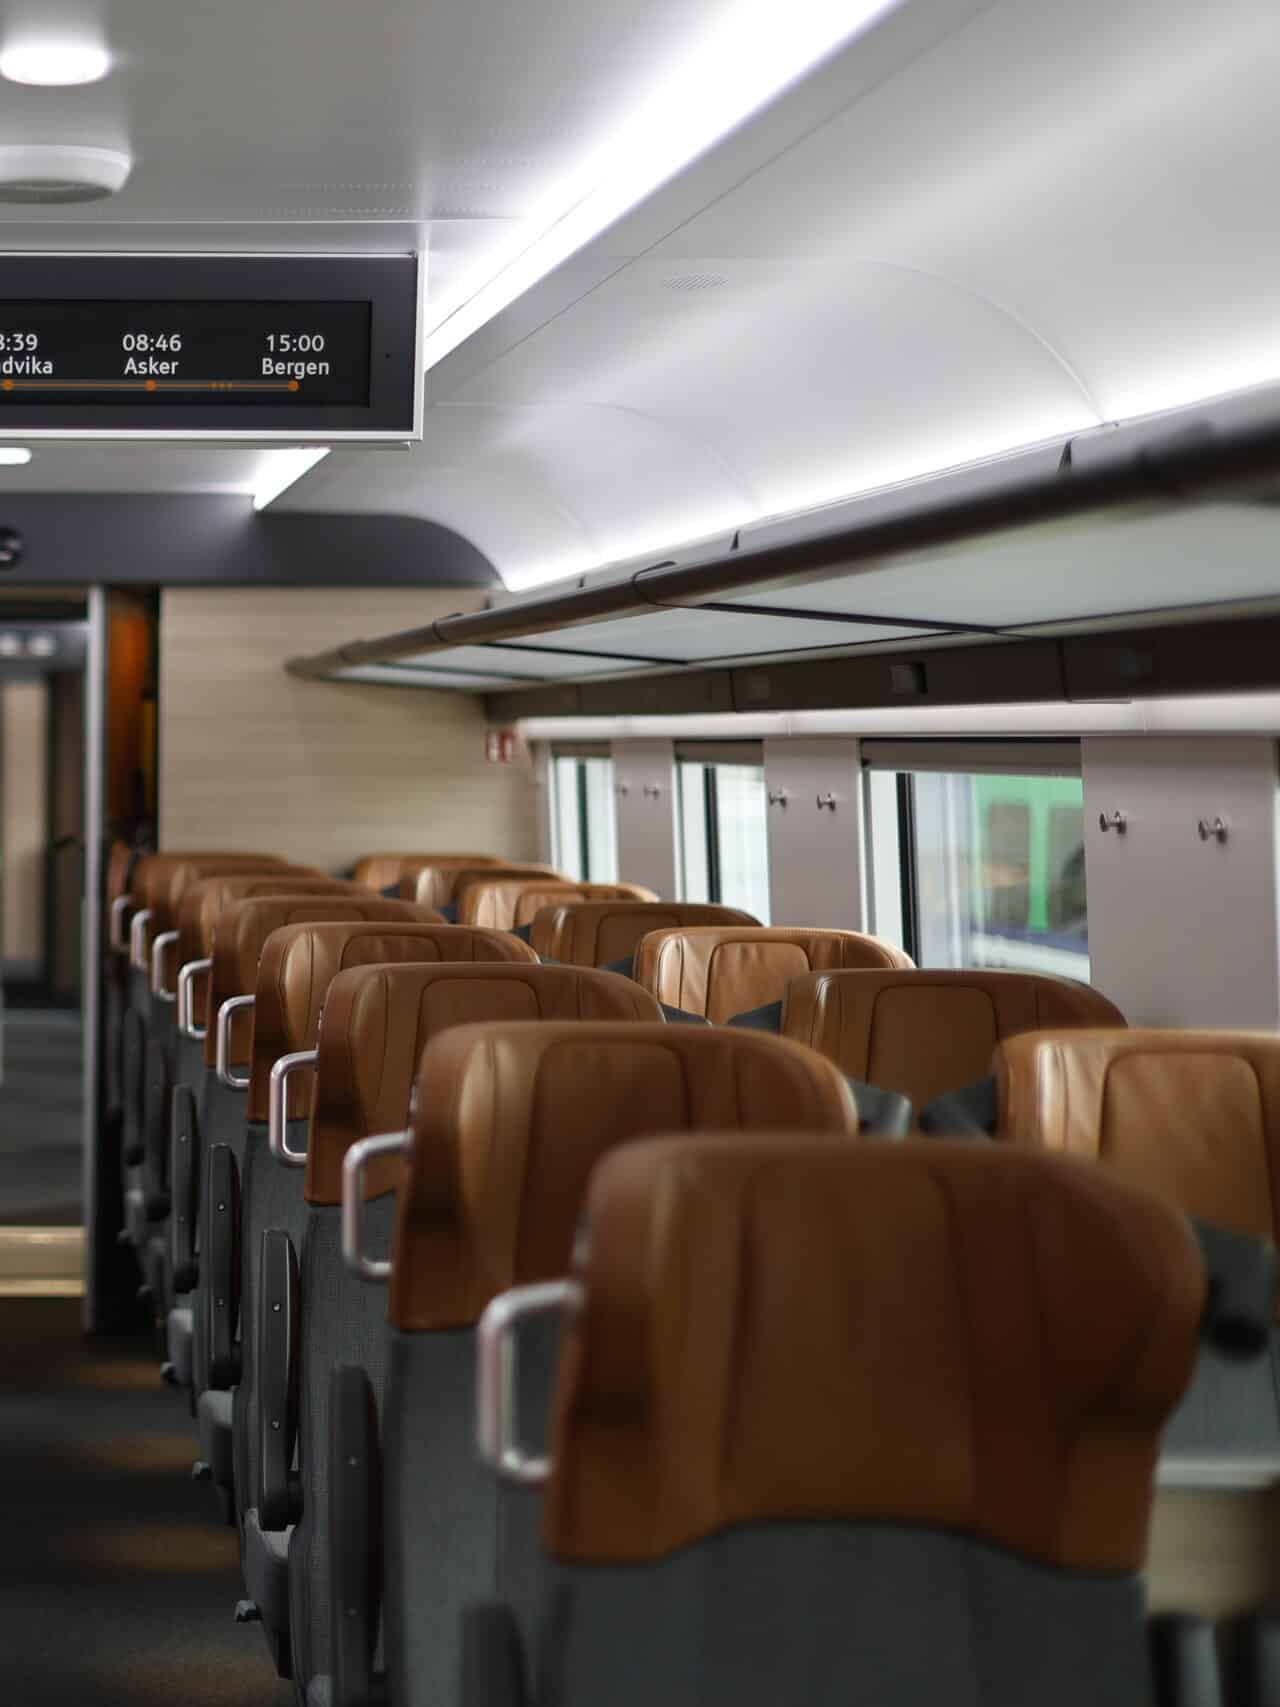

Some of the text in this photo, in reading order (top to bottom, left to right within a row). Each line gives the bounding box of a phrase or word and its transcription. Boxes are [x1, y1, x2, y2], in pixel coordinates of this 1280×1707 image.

[122, 333, 182, 352] 08:46
[266, 334, 325, 353] 15:00
[123, 355, 179, 375] Asker
[261, 357, 330, 379] Bergen
